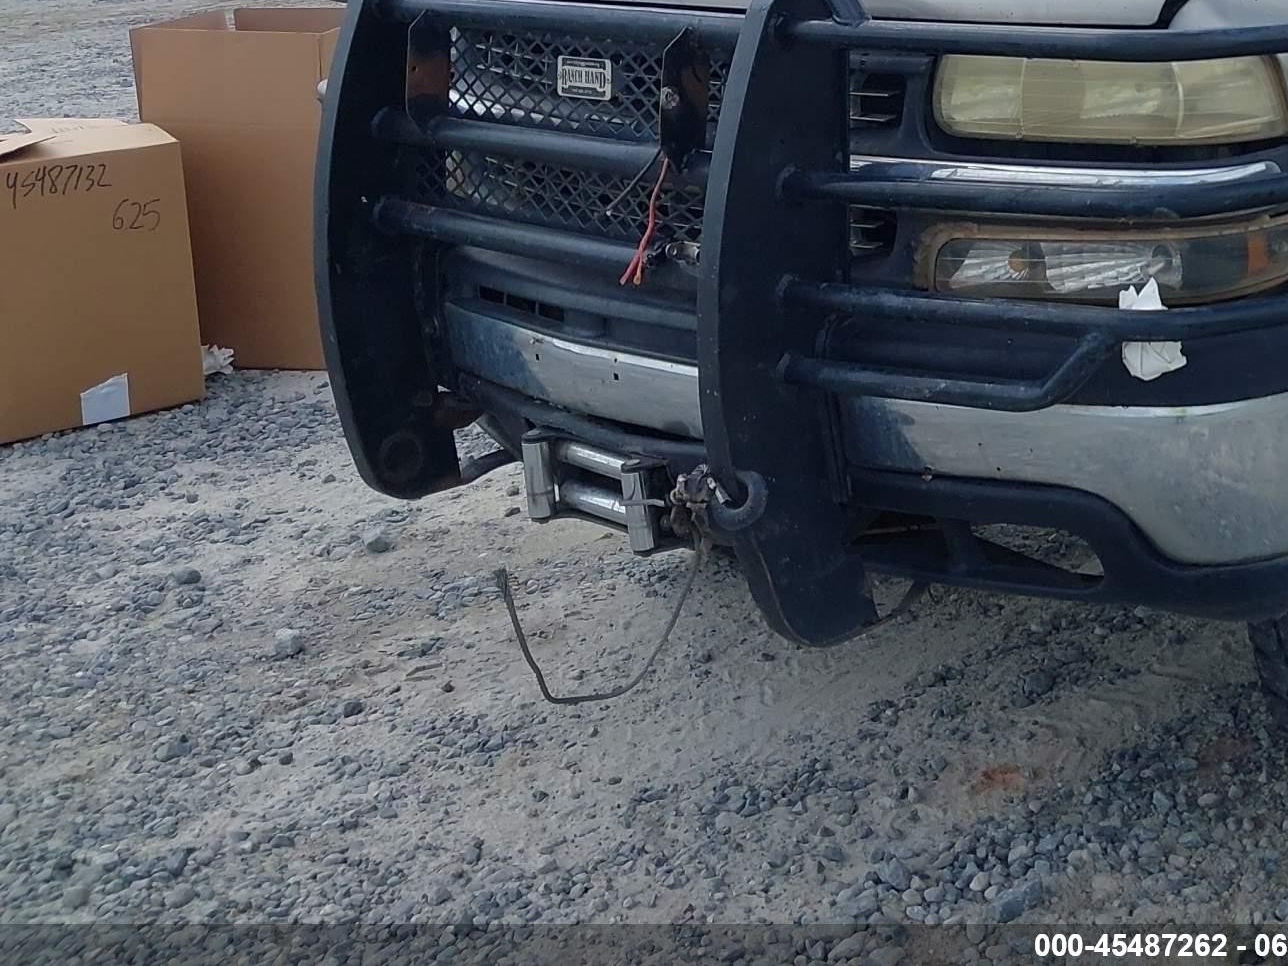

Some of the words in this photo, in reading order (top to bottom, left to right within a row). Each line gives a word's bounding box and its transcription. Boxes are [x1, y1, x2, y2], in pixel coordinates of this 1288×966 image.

[562, 67, 583, 85] RANCH
[585, 70, 606, 89] HAND
[6, 164, 112, 209] 45487132
[112, 198, 161, 231] 625
